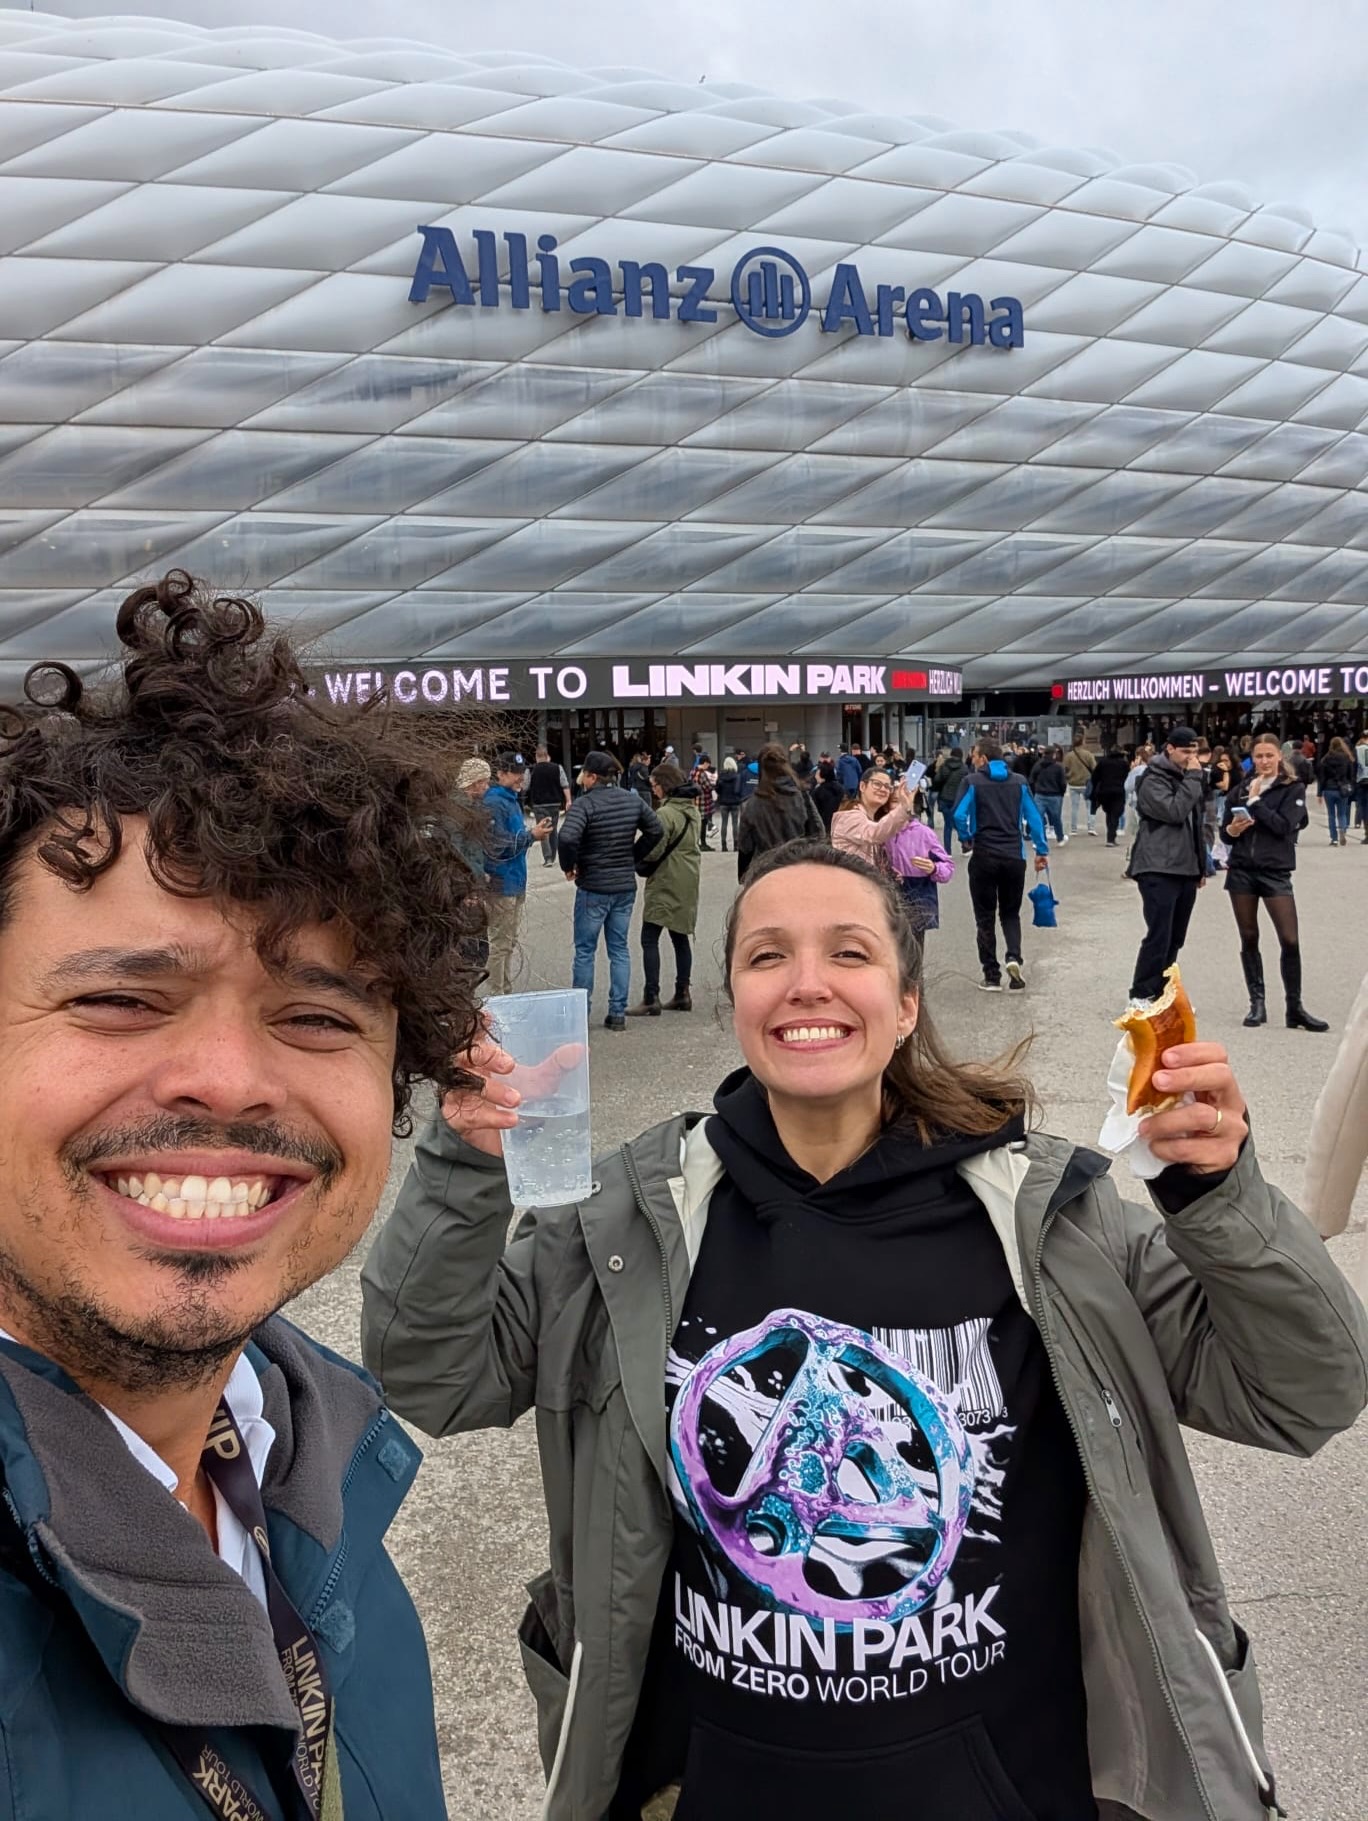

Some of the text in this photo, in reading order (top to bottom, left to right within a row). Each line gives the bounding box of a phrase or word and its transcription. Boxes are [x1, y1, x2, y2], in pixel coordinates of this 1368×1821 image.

[408, 225, 1024, 348] Allianz Arena
[324, 664, 887, 704] WELCOME TO LINKIN PARK
[1067, 680, 1110, 701] HERZLICH
[1113, 675, 1204, 699] WILLKOMMEN
[1225, 668, 1332, 696] WELCOME
[1340, 666, 1368, 692] TO
[959, 1407, 1008, 1426] 3073 3
[675, 1571, 1006, 1671] LINKIN PARK
[292, 1635, 326, 1738] LINKIN
[675, 1623, 1005, 1702] FROM ZERO WORLD TOUR
[201, 1744, 231, 1783] TOUR
